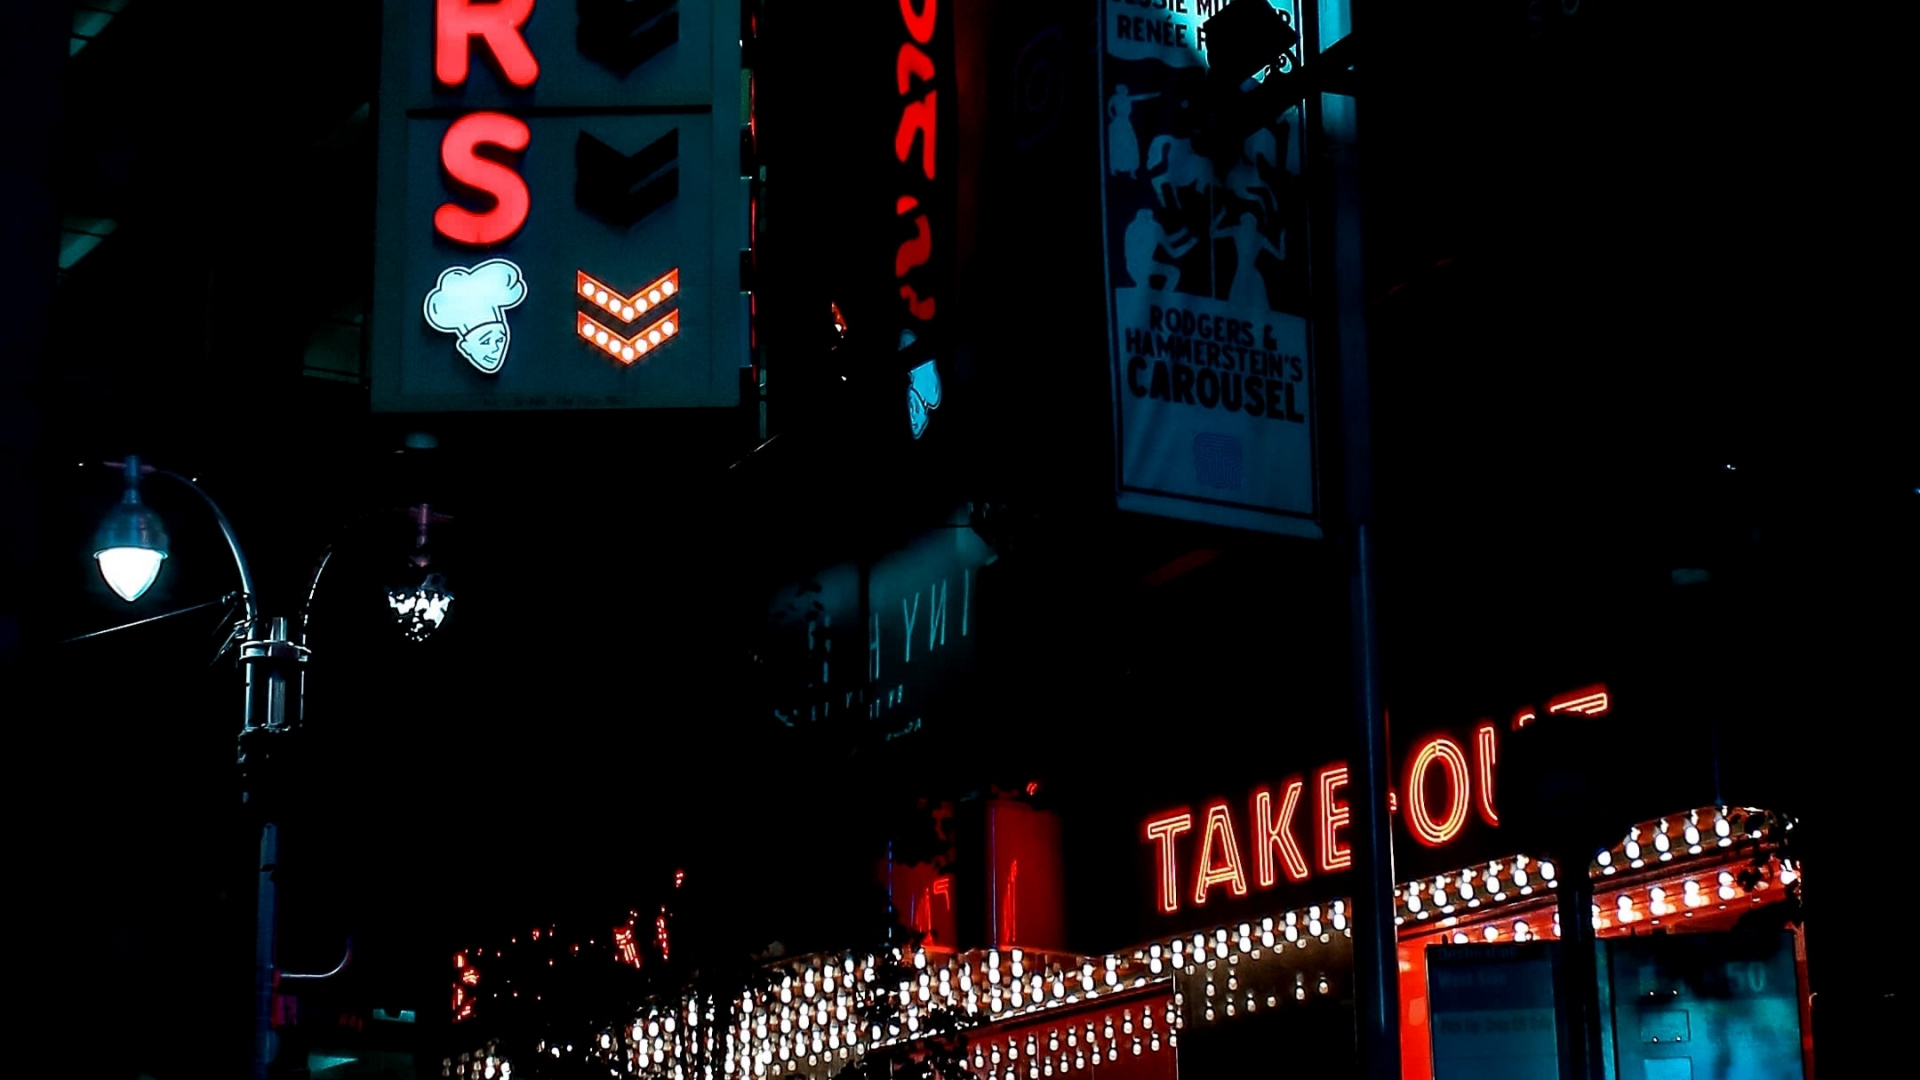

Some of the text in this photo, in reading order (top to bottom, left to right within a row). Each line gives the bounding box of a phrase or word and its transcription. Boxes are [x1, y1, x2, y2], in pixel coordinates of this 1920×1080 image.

[1117, 13, 1188, 48] RENÉE
[1150, 305, 1278, 350] RODGERS &
[1126, 328, 1304, 382] HAMMERSTEIN'S
[1127, 356, 1304, 423] CAROUSEL
